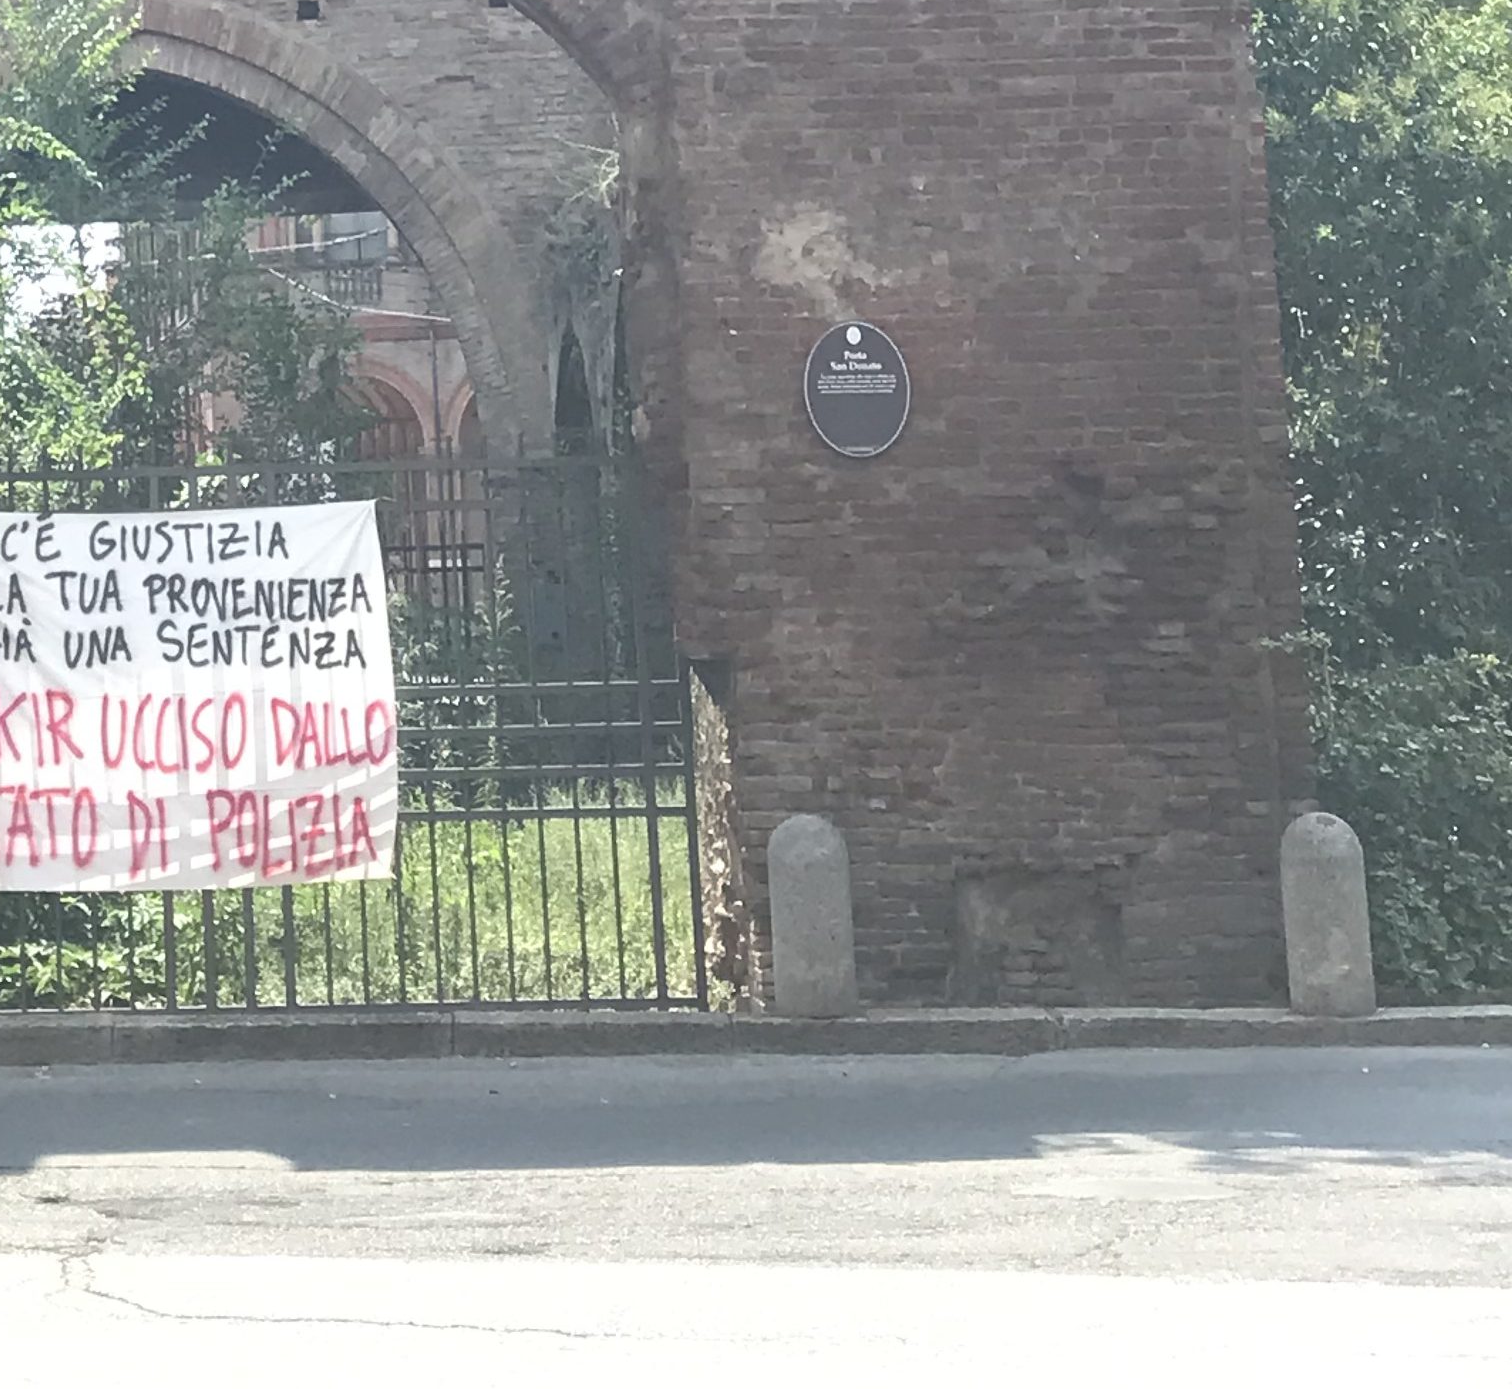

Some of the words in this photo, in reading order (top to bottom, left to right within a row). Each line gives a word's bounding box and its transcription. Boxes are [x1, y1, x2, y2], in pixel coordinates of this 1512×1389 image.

[89, 520, 289, 564] GIUSTIZIA
[44, 568, 123, 614] TUA
[142, 572, 373, 623] PROVENIENZA
[63, 625, 133, 670] UNA
[156, 618, 367, 670] SENTENZA
[100, 690, 248, 775] UCCISO
[271, 696, 392, 770] DALLO
[126, 789, 169, 880] DI
[205, 788, 378, 879] POLIZIA
